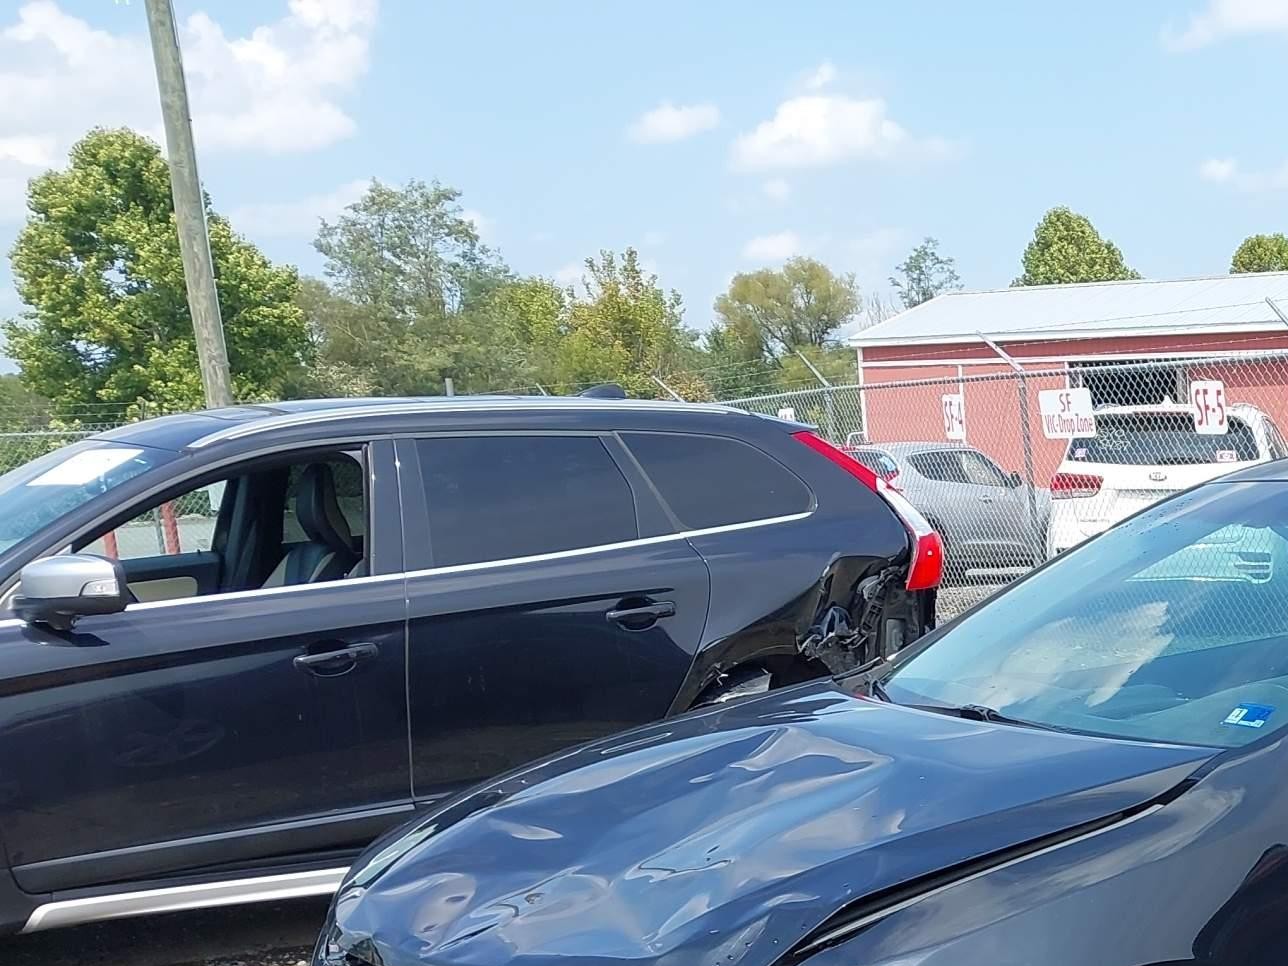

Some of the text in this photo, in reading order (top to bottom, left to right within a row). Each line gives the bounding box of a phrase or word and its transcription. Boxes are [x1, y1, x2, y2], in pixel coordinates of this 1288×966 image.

[1058, 392, 1072, 412] SF
[1194, 388, 1225, 427] SF-5
[944, 400, 964, 432] SF-4
[1075, 413, 1094, 433] Zone
